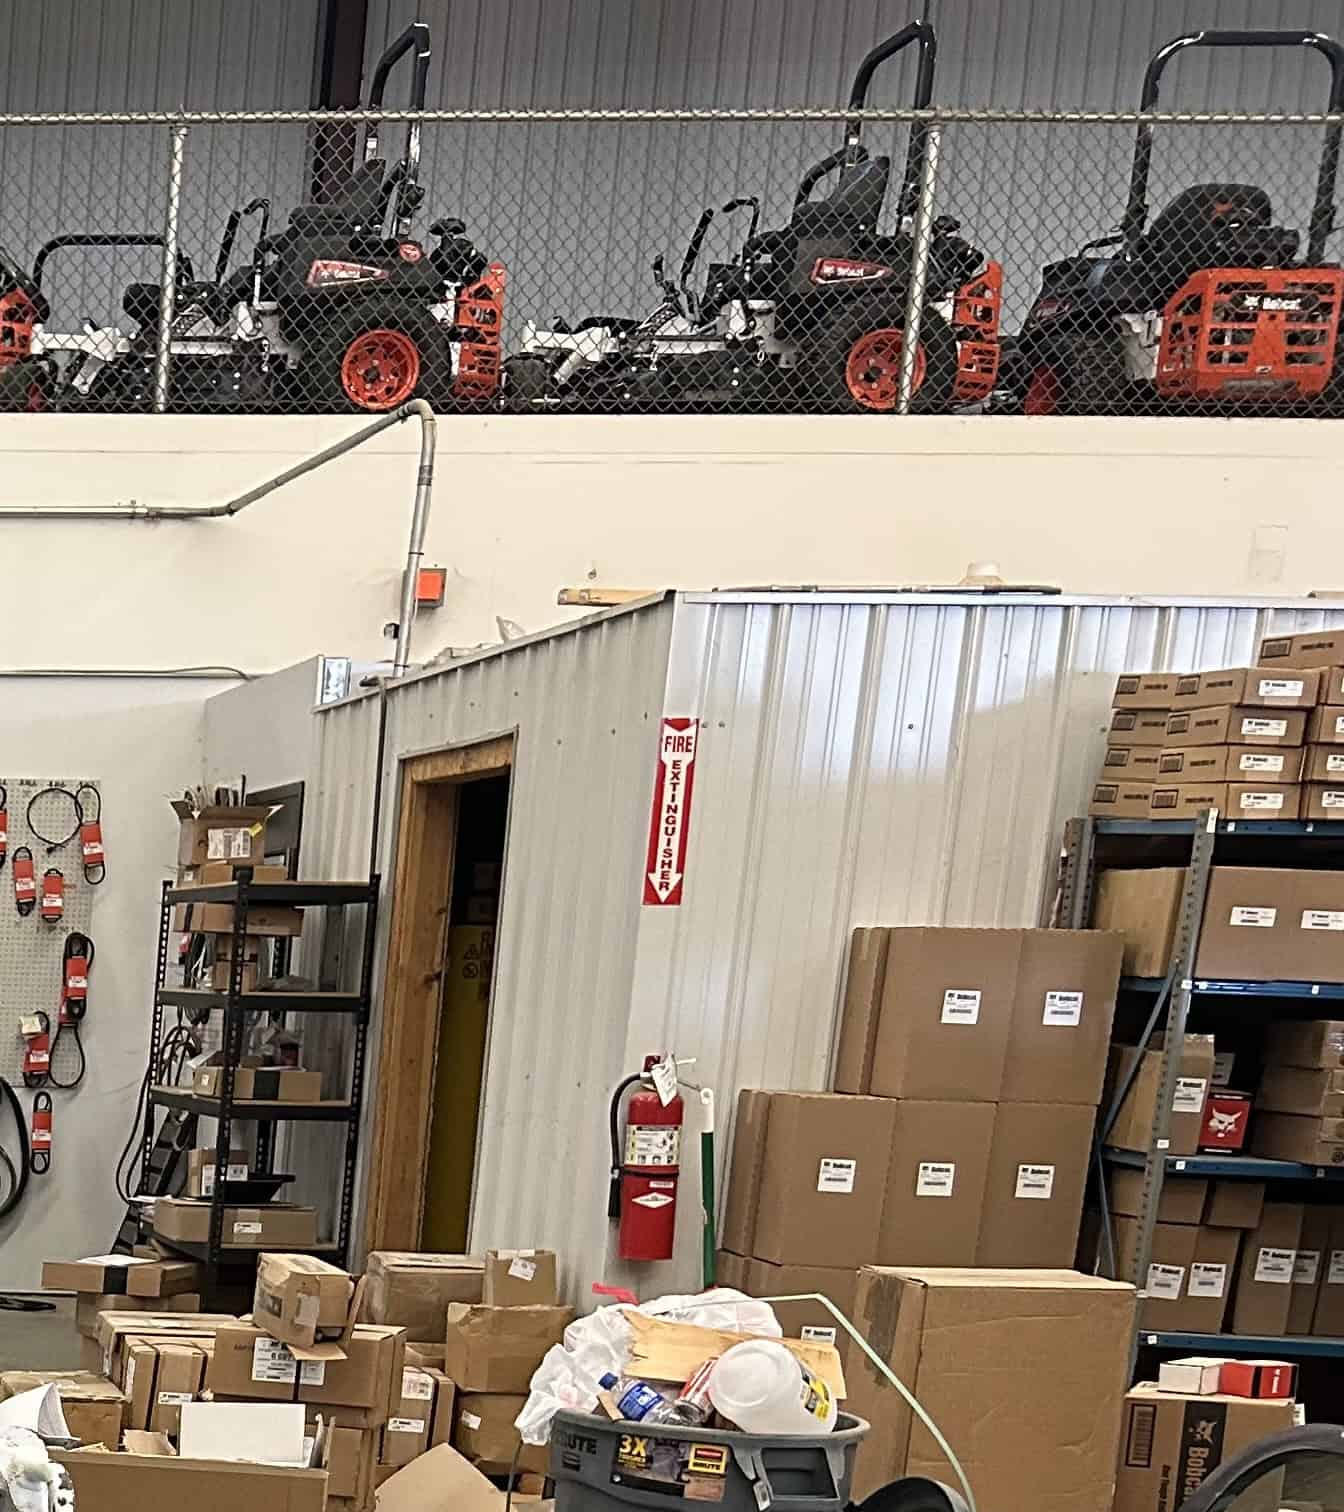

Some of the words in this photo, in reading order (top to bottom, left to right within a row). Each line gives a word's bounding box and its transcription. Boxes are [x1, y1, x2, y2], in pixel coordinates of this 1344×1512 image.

[664, 735, 693, 753] FIRE
[658, 759, 682, 892] EXTINGUISHER
[618, 1434, 649, 1458] 3X
